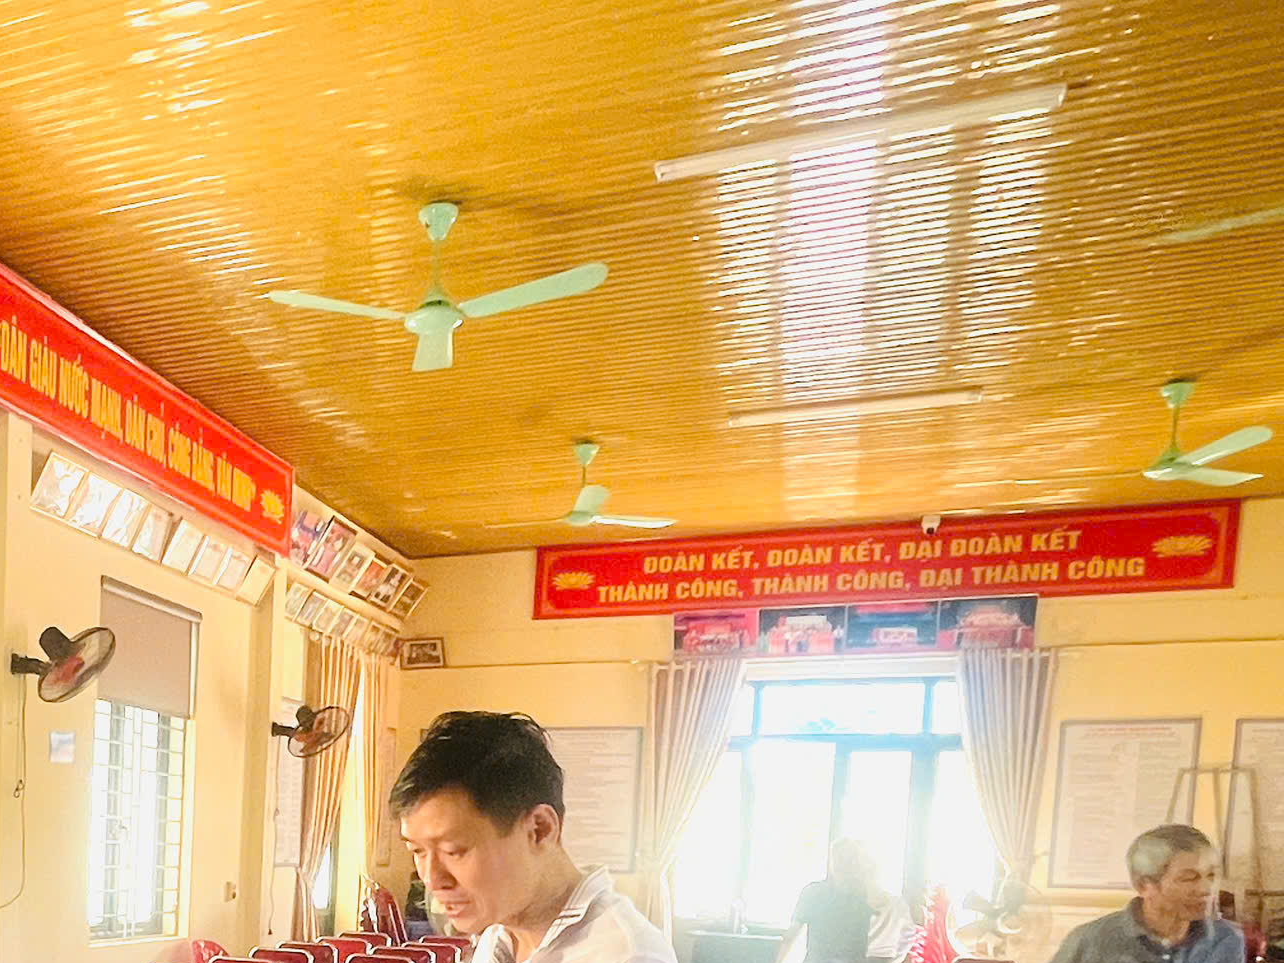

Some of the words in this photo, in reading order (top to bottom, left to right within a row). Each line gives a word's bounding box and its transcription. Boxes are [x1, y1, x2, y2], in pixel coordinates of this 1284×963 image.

[29, 336, 58, 401] GIÀU
[643, 551, 706, 575] ĐOÀN
[712, 544, 760, 571] KẾT,
[767, 543, 833, 568] ĐOÀN
[839, 537, 892, 564] KẾT,
[899, 540, 944, 563] ĐẠI
[950, 532, 1023, 558] ĐOÀN
[1031, 525, 1083, 553] KẾT
[597, 581, 669, 603] THÀNH
[675, 574, 744, 599] CÔNG,
[752, 573, 829, 596] THÀNH
[835, 568, 912, 592] CÔNG,
[919, 566, 964, 591] ĐẠI
[971, 560, 1060, 585] THÀNH
[1068, 555, 1146, 581] CÔNG
